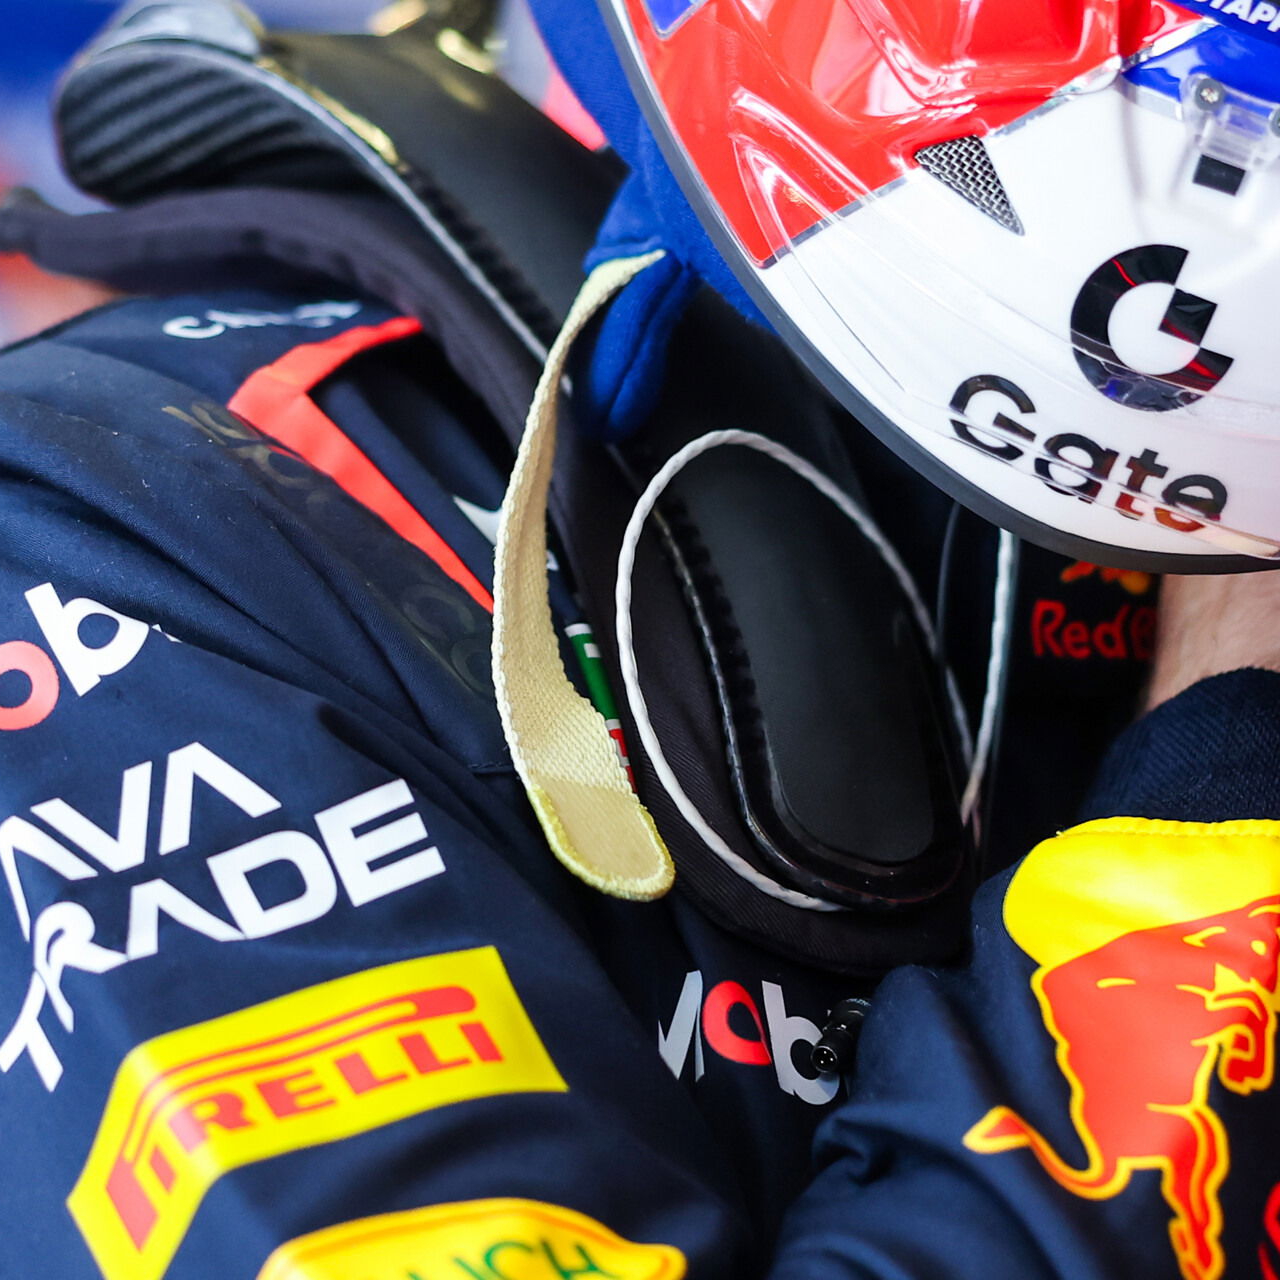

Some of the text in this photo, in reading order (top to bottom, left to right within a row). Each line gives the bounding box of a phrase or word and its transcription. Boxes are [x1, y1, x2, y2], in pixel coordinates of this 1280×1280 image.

[949, 374, 1230, 532] Gate
[1030, 598, 1131, 659] Red
[105, 984, 505, 1255] PIRELLI
